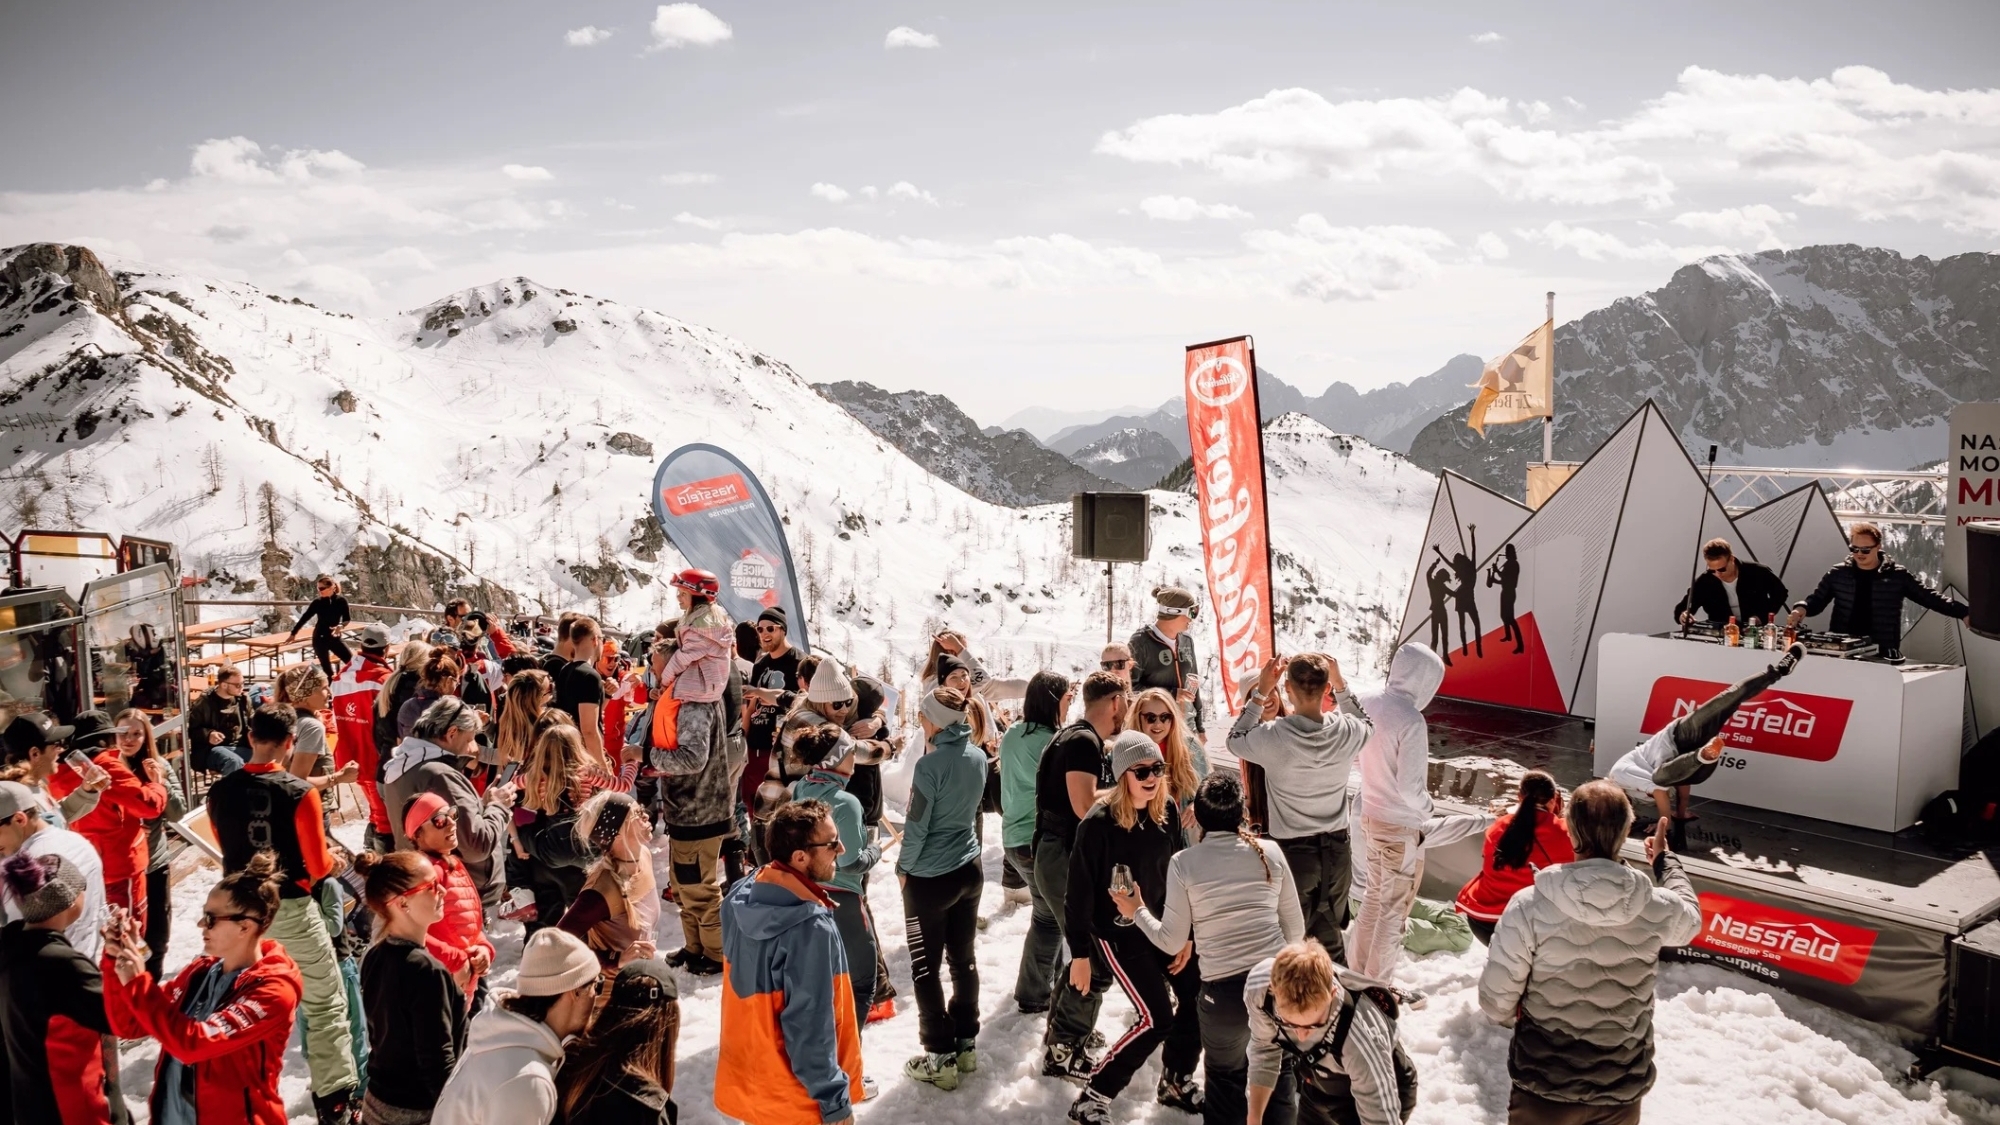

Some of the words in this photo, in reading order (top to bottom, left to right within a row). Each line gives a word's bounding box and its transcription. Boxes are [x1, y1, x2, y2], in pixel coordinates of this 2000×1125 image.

[1961, 434, 2000, 450] NA
[1958, 477, 2000, 506] M
[1672, 697, 1816, 738] Nsfeld
[1732, 732, 1753, 744] See
[1705, 935, 1760, 956] Pressegger
[1762, 949, 1782, 961] See
[1709, 912, 1840, 963] Nassfeld
[1677, 947, 1711, 960] nice
[1715, 954, 1780, 980] surprise
